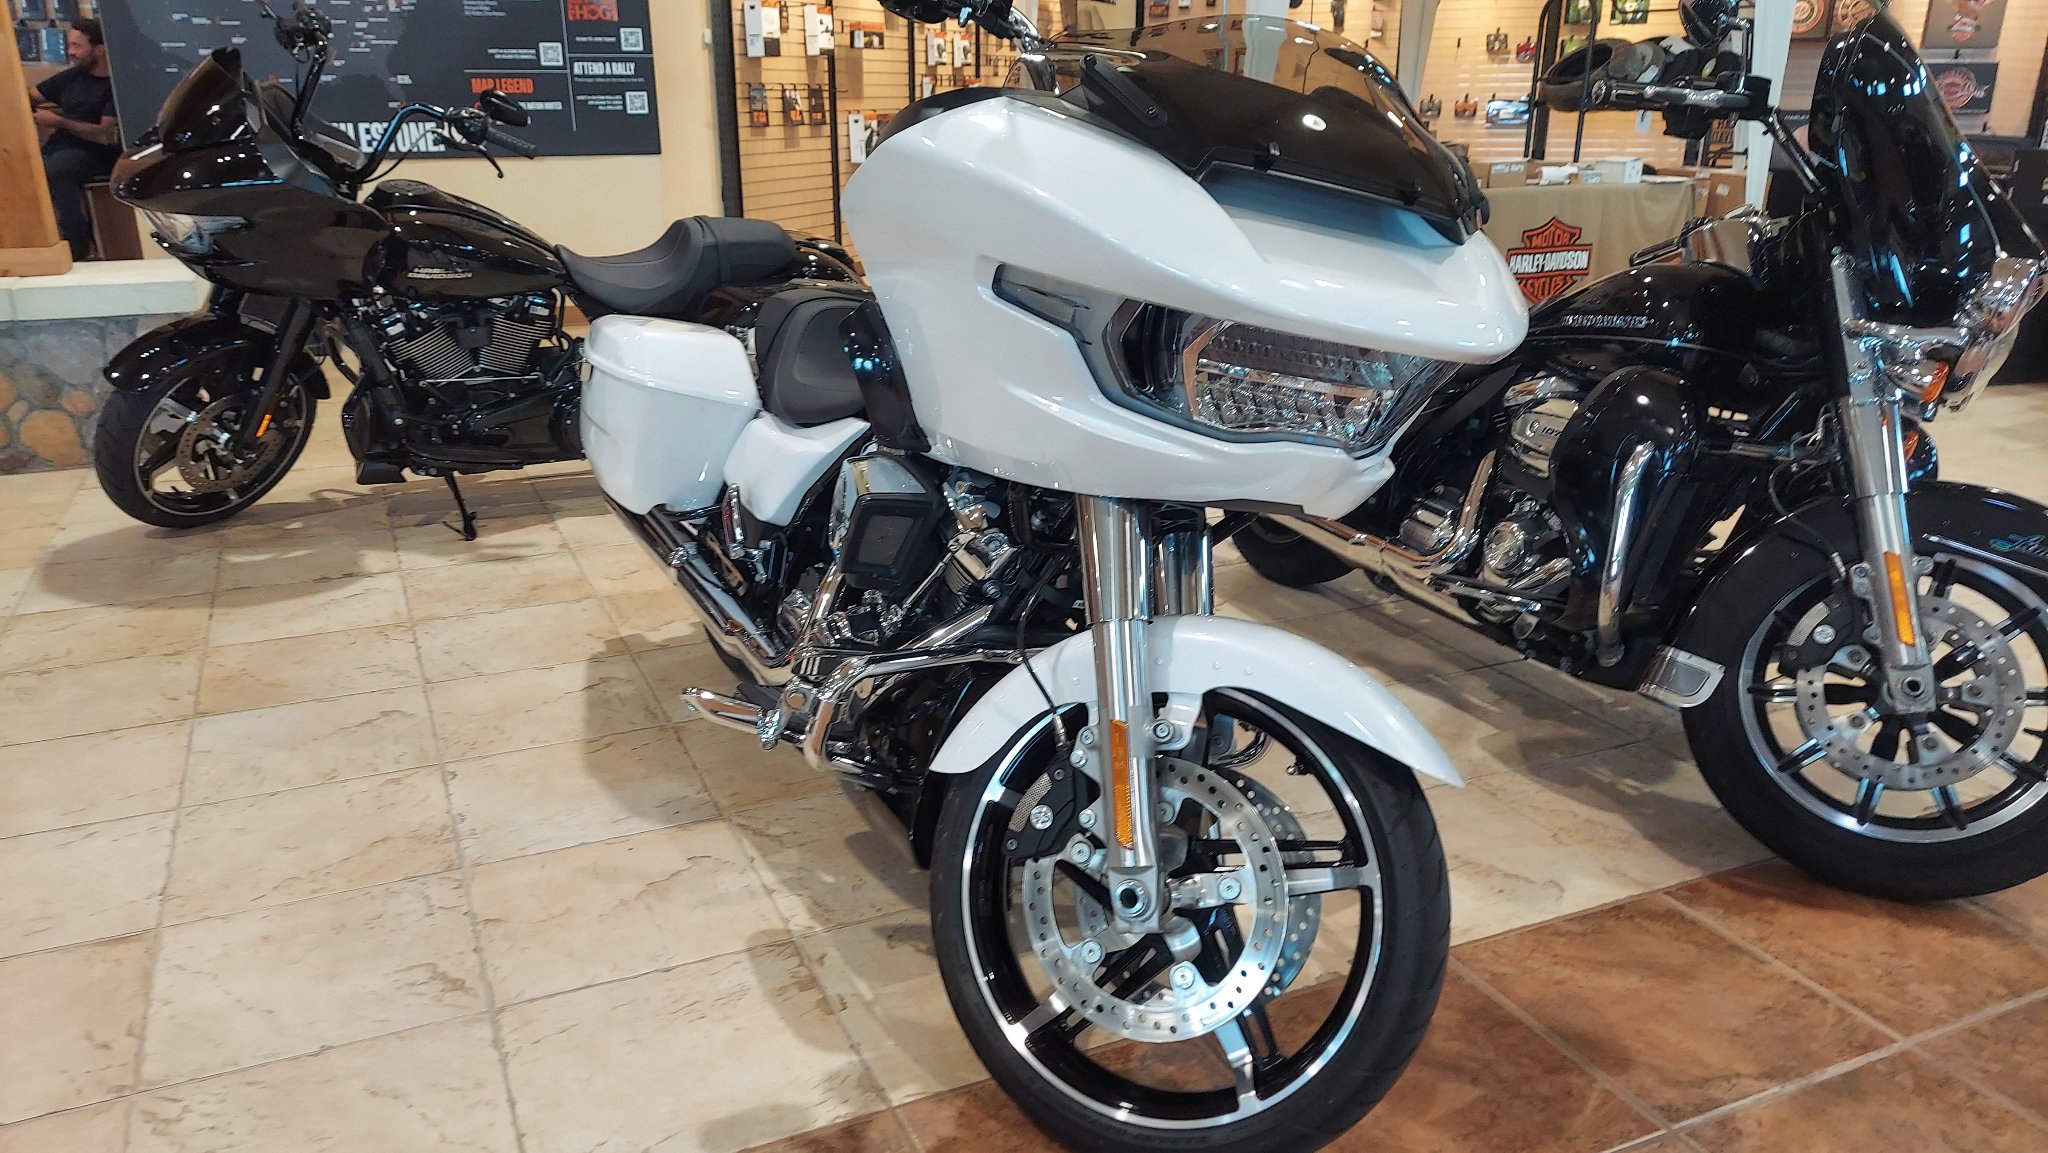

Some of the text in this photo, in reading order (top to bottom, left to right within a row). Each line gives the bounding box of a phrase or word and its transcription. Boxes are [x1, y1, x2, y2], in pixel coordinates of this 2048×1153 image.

[573, 62, 635, 75] ATTEND A RALLY
[471, 78, 534, 93] MAP LEGEND
[1530, 226, 1571, 247] MOTOR
[1509, 250, 1590, 274] HARLEY-DAVIDSON
